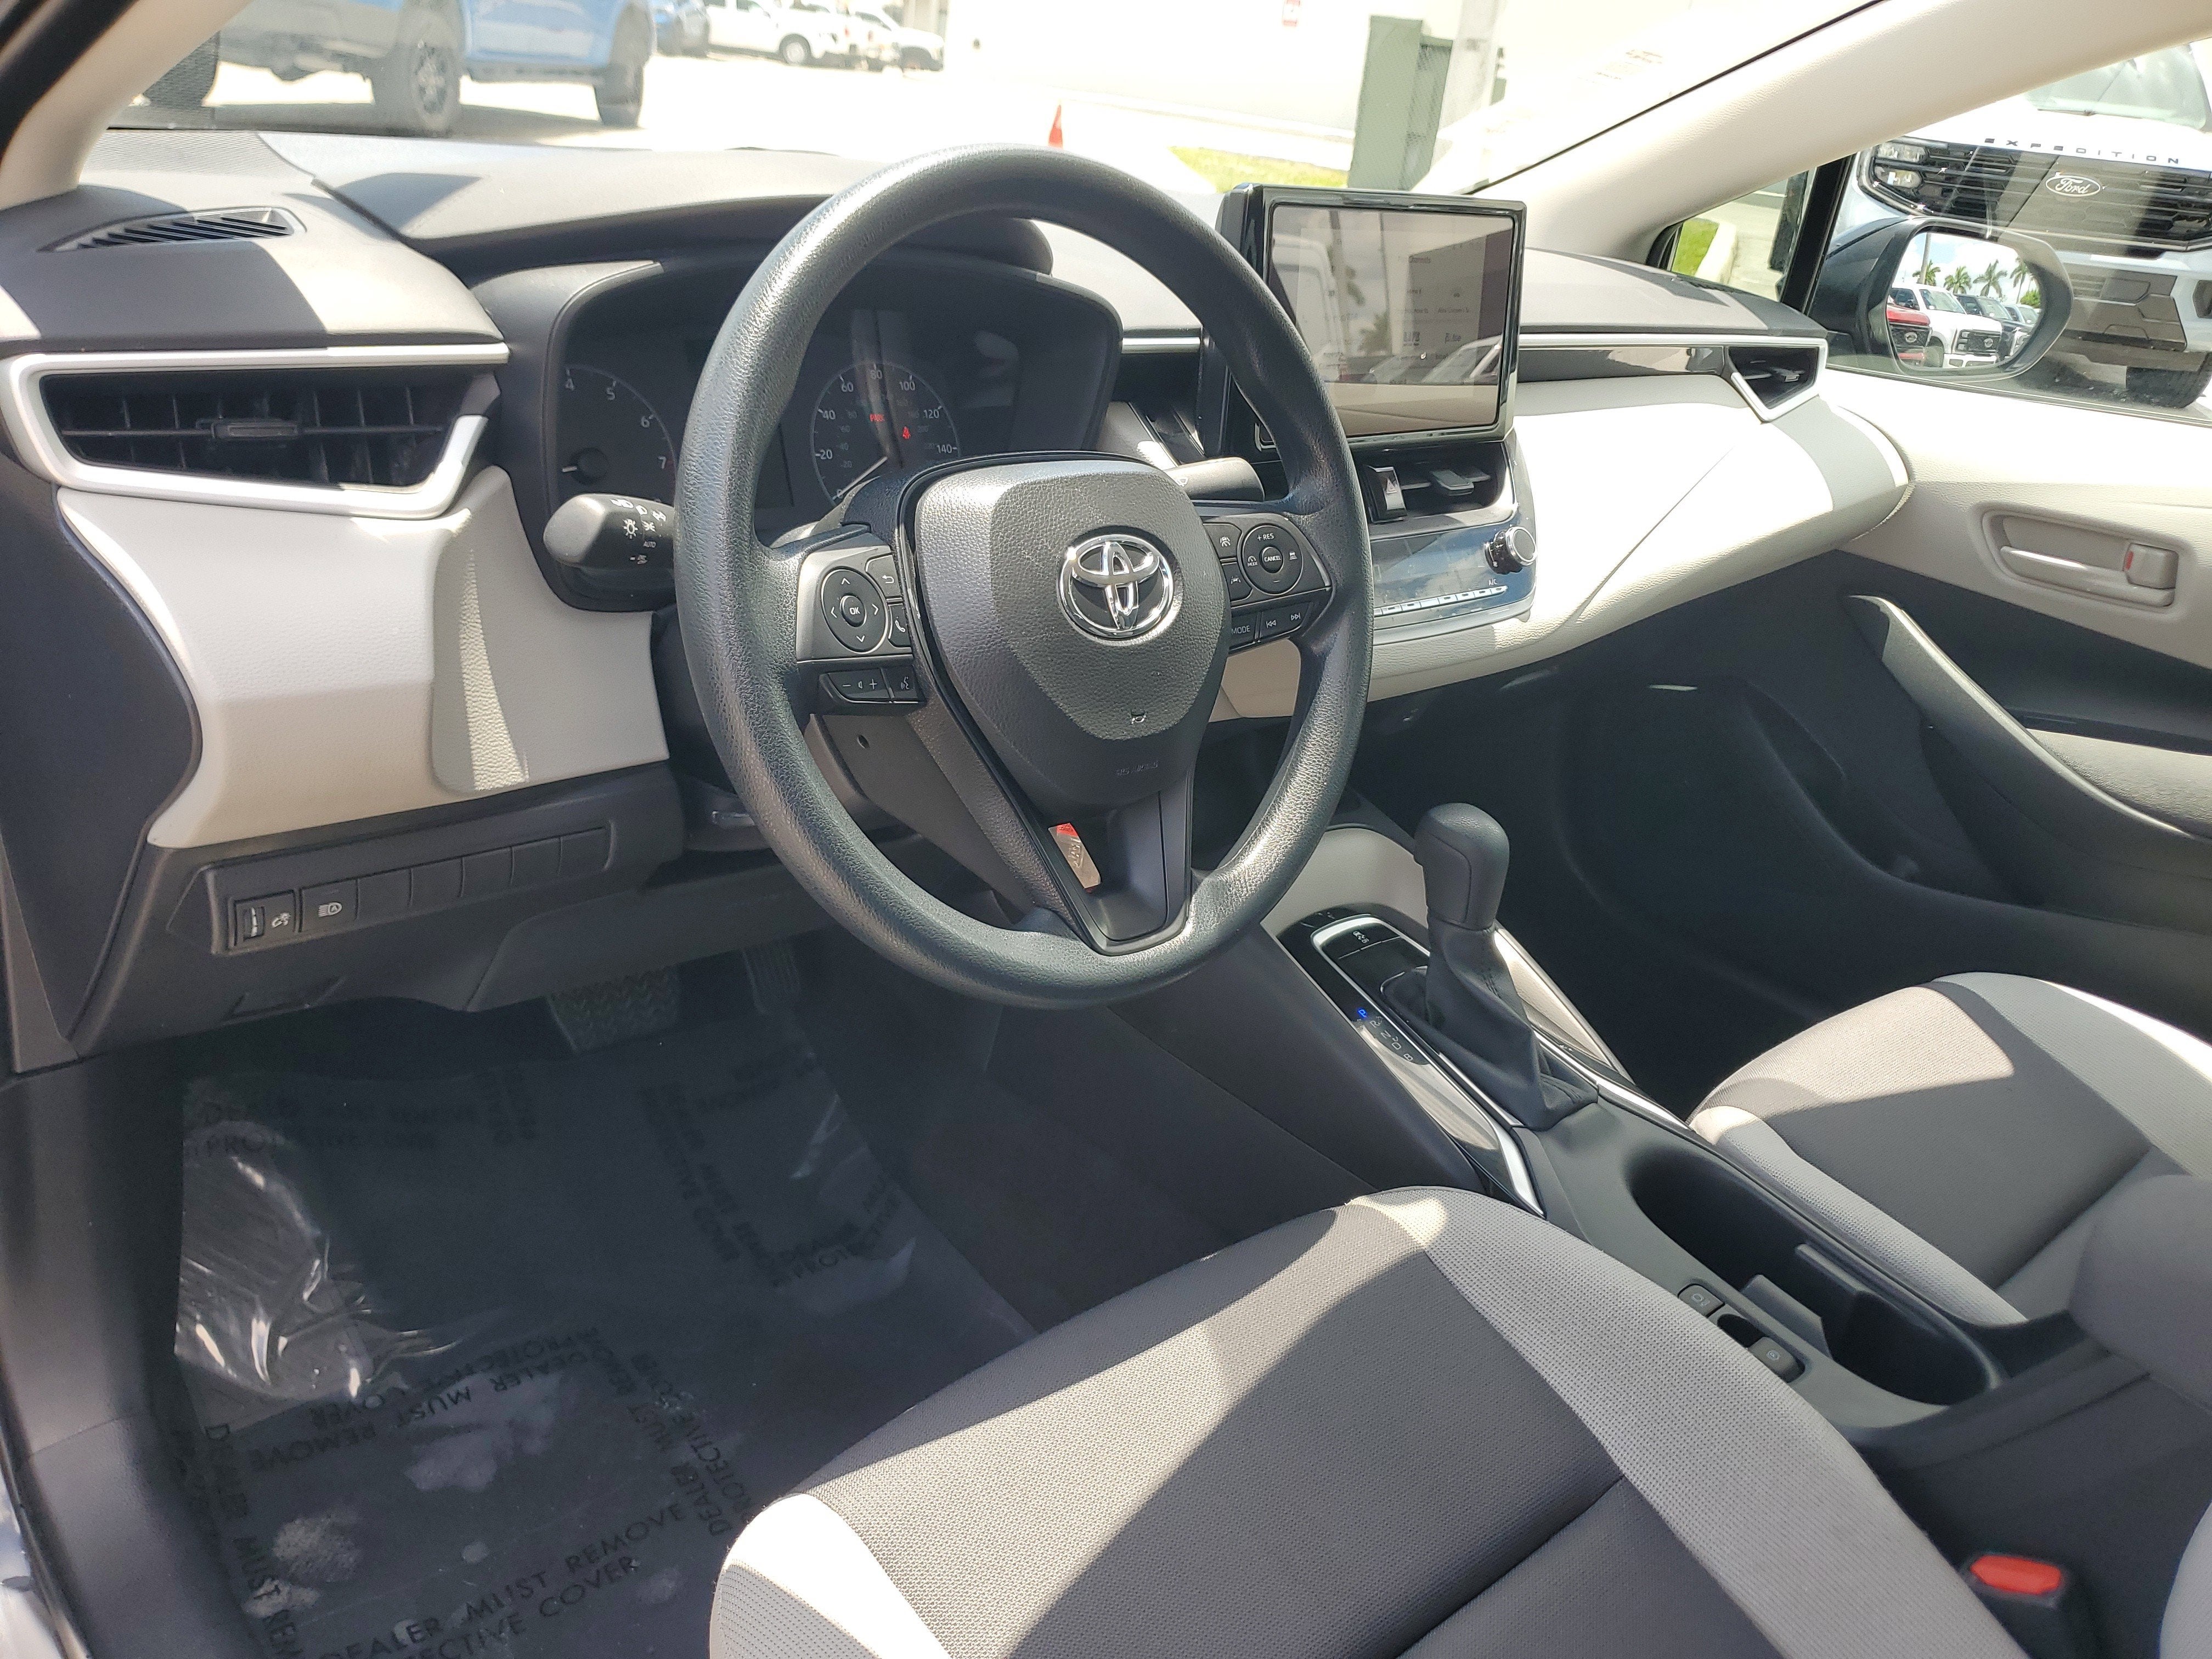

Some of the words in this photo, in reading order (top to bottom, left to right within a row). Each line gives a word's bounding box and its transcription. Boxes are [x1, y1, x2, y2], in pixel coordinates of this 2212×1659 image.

[1984, 138, 2179, 165] EXPEDITION
[2055, 178, 2091, 194] Ford
[870, 369, 882, 379] 80
[565, 378, 575, 391] 4
[842, 382, 854, 392] 60
[900, 381, 916, 391] 100
[606, 387, 616, 400] 5
[823, 410, 836, 420] 40
[923, 409, 940, 419] 120
[640, 416, 651, 428] 6
[820, 449, 833, 460] 20
[936, 444, 952, 454] 140
[658, 456, 667, 470] 7
[849, 607, 860, 616] OK
[1231, 624, 1251, 635] MODE
[1357, 1008, 1367, 1018] P
[1370, 1020, 1379, 1029] R
[1380, 1030, 1391, 1039] N
[1391, 1042, 1402, 1051] D
[466, 1570, 548, 1622] MUST
[565, 1503, 685, 1575] REMOVE
[539, 1556, 639, 1618] COVER
